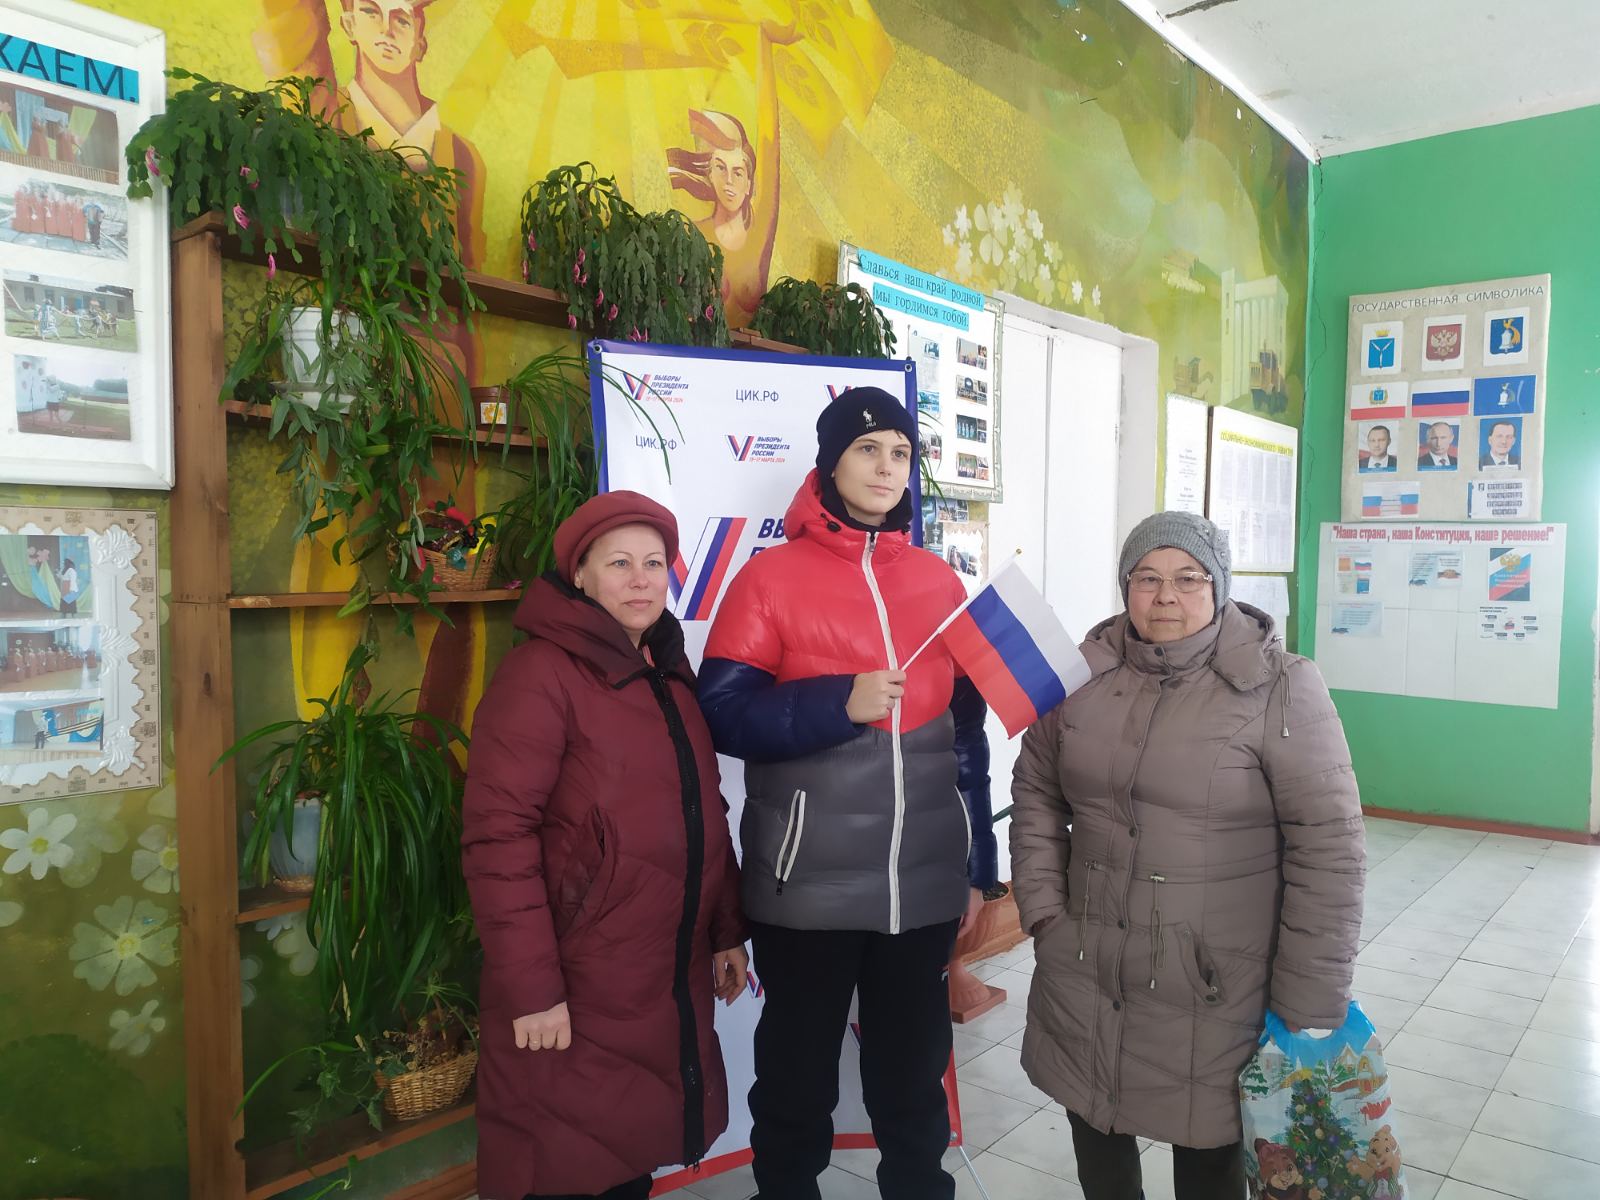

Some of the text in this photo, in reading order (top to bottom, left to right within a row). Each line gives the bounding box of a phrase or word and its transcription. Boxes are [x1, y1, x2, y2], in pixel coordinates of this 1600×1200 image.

[859, 254, 900, 281] Славься
[904, 274, 924, 289] наш
[926, 280, 947, 296] край
[875, 288, 891, 303] мы
[895, 296, 939, 318] гордимся
[1352, 285, 1544, 313] ГОСУДАРСТВЕННАЯ СИМВОЛИКА
[654, 374, 681, 382] ВЫБОРЫ
[735, 389, 779, 402] ЦИК.РФ
[1392, 529, 1413, 540] наша
[1415, 526, 1472, 544] Конституция,
[1474, 529, 1499, 541] наше
